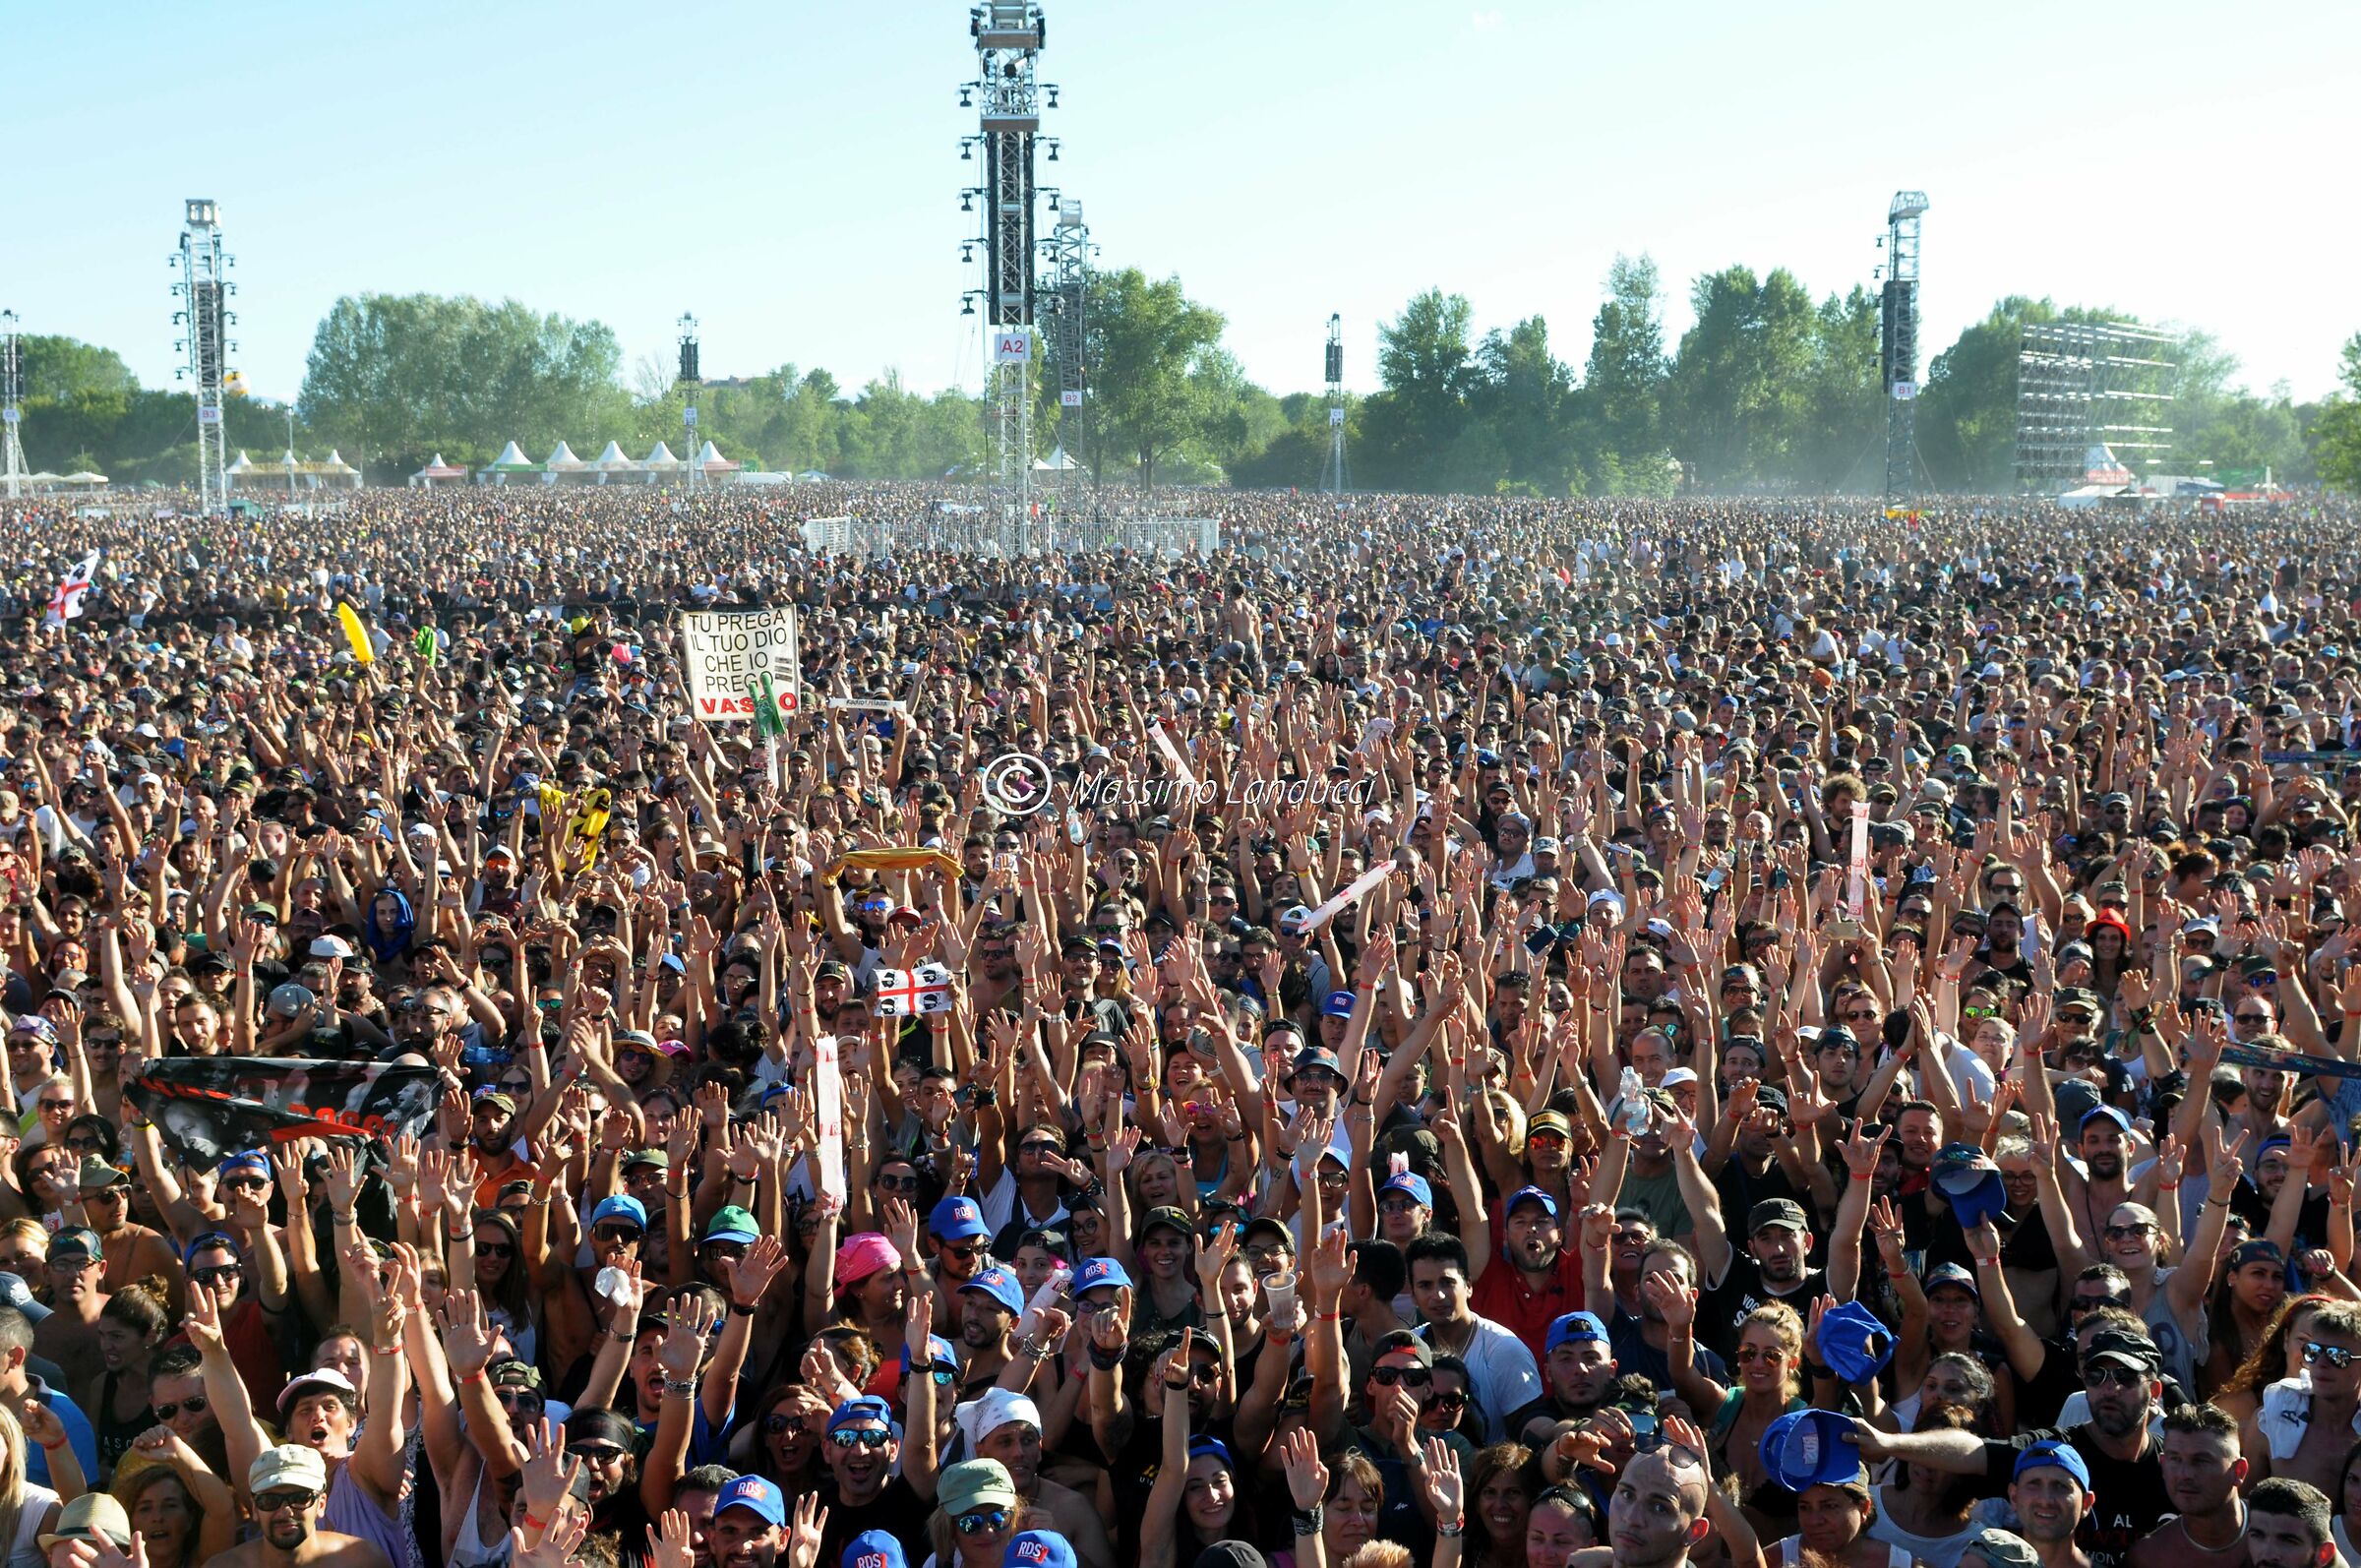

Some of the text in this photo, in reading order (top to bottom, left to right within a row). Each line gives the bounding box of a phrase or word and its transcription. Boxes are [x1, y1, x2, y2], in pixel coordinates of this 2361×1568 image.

[1001, 339, 1024, 353] A2
[1899, 386, 1910, 394] B1
[203, 409, 215, 418] B3
[689, 609, 786, 633] TU PREGA
[691, 627, 787, 652] IL TUO DIO
[704, 654, 743, 673] CHE
[749, 651, 768, 670] IO
[699, 692, 798, 714] VASO
[1394, 1176, 1412, 1186] RDS
[954, 1205, 973, 1220] RDS
[981, 1272, 1000, 1284] RDS
[1085, 1264, 1103, 1279] RDS
[738, 1480, 761, 1496] RDS
[1017, 1541, 1042, 1557] RDS
[857, 1553, 881, 1568] RDS
